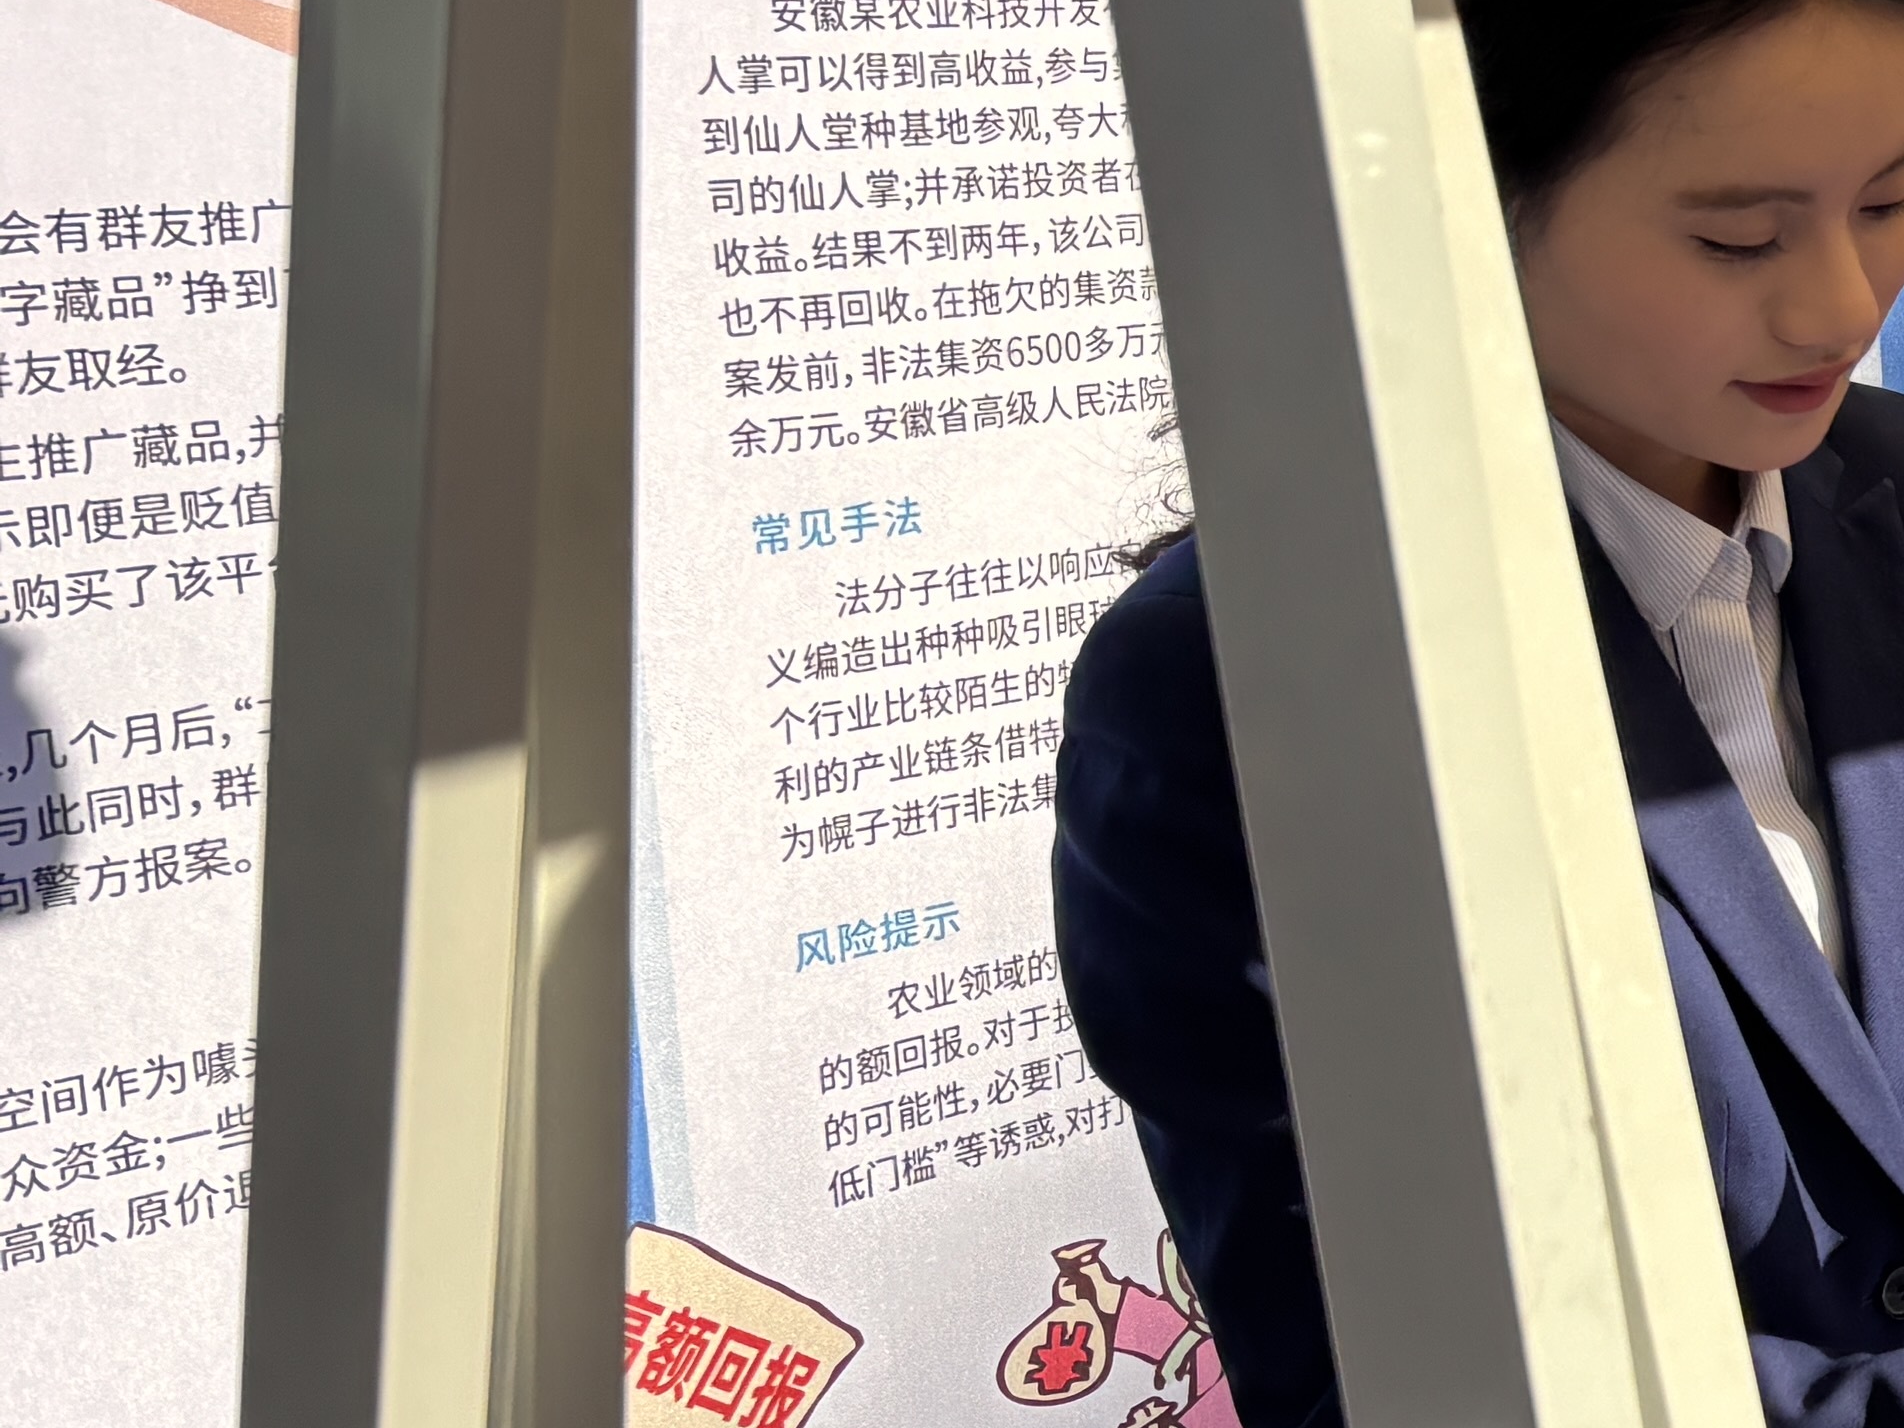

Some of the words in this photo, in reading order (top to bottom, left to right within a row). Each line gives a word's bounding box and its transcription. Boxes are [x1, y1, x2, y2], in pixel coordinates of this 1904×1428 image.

[697, 47, 1124, 96] 人掌可以得到高收益,参与
[701, 103, 1136, 155] 到仙人堂种基地参观,夸大
[752, 497, 925, 557] 常见手法
[795, 900, 961, 974] 风险提示
[887, 948, 1060, 1020] 农业领域的
[823, 1047, 1099, 1153] 的可能性,必要门
